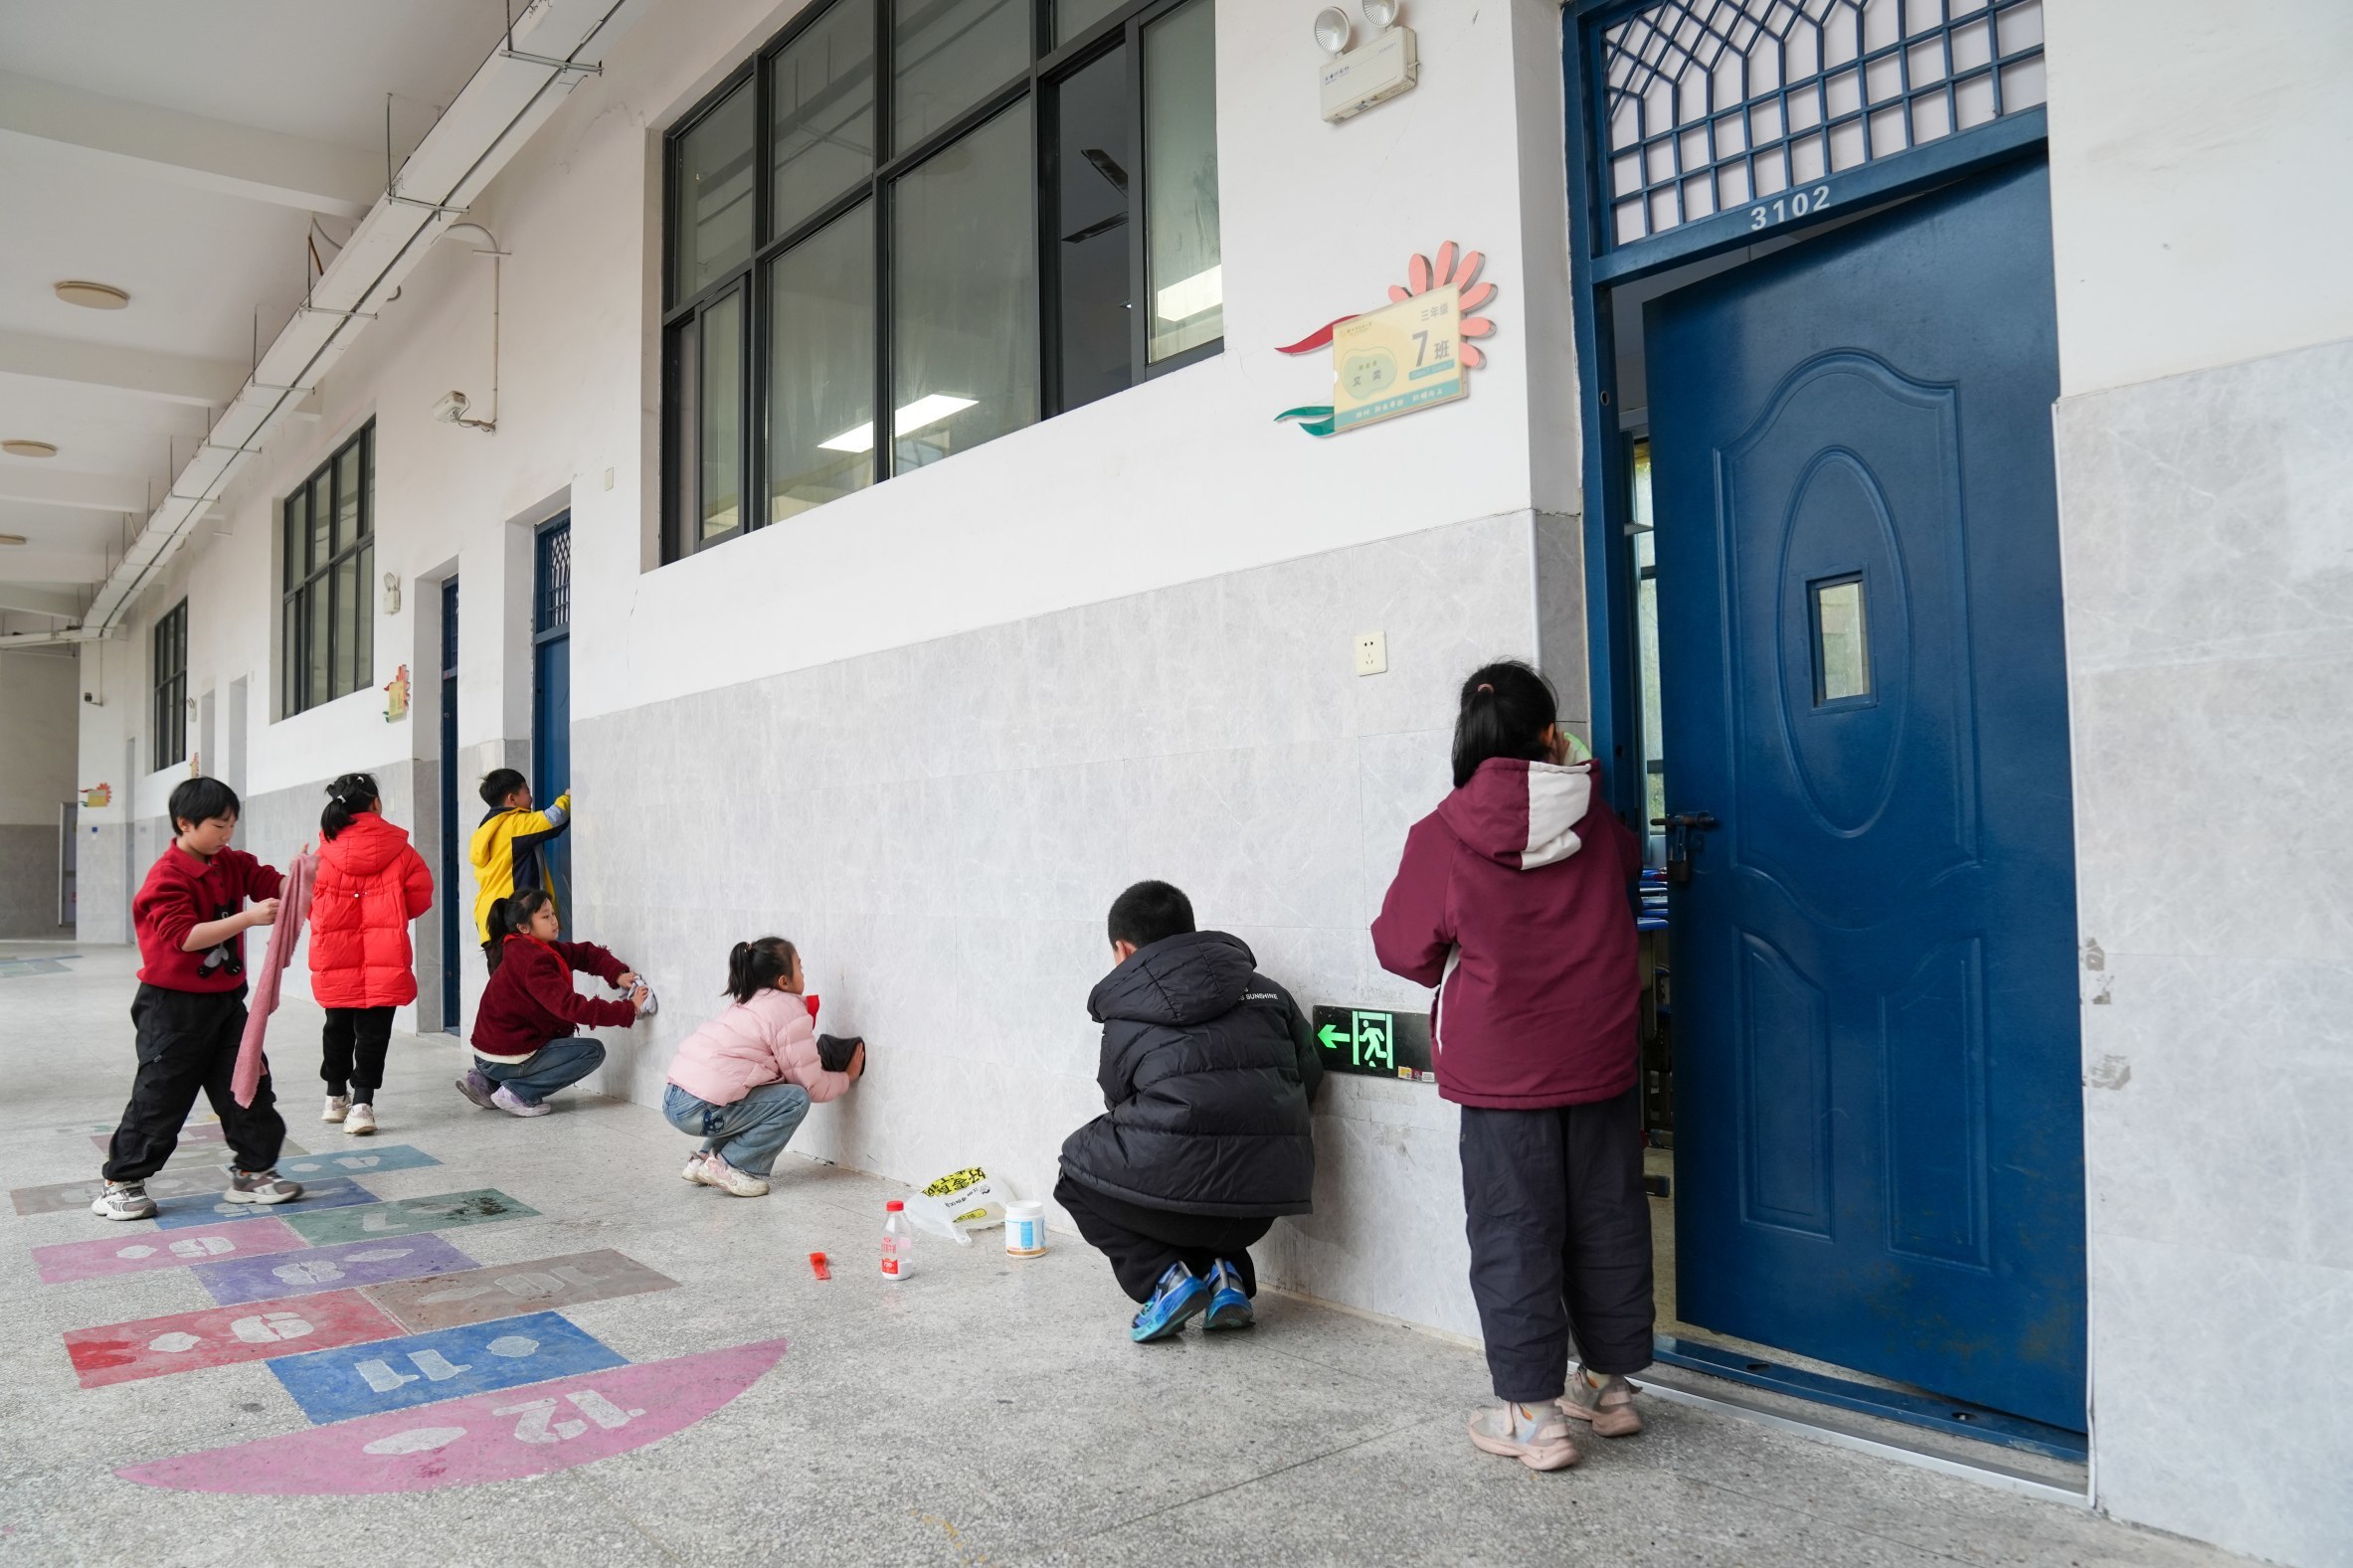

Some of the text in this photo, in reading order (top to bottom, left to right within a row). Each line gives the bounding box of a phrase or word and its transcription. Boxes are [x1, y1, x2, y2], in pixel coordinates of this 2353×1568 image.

[1750, 186, 1830, 231] 3102
[1420, 302, 1449, 322] 三年级
[272, 1260, 346, 1286] 8
[353, 1348, 472, 1393] 11
[491, 1389, 647, 1445] 12
